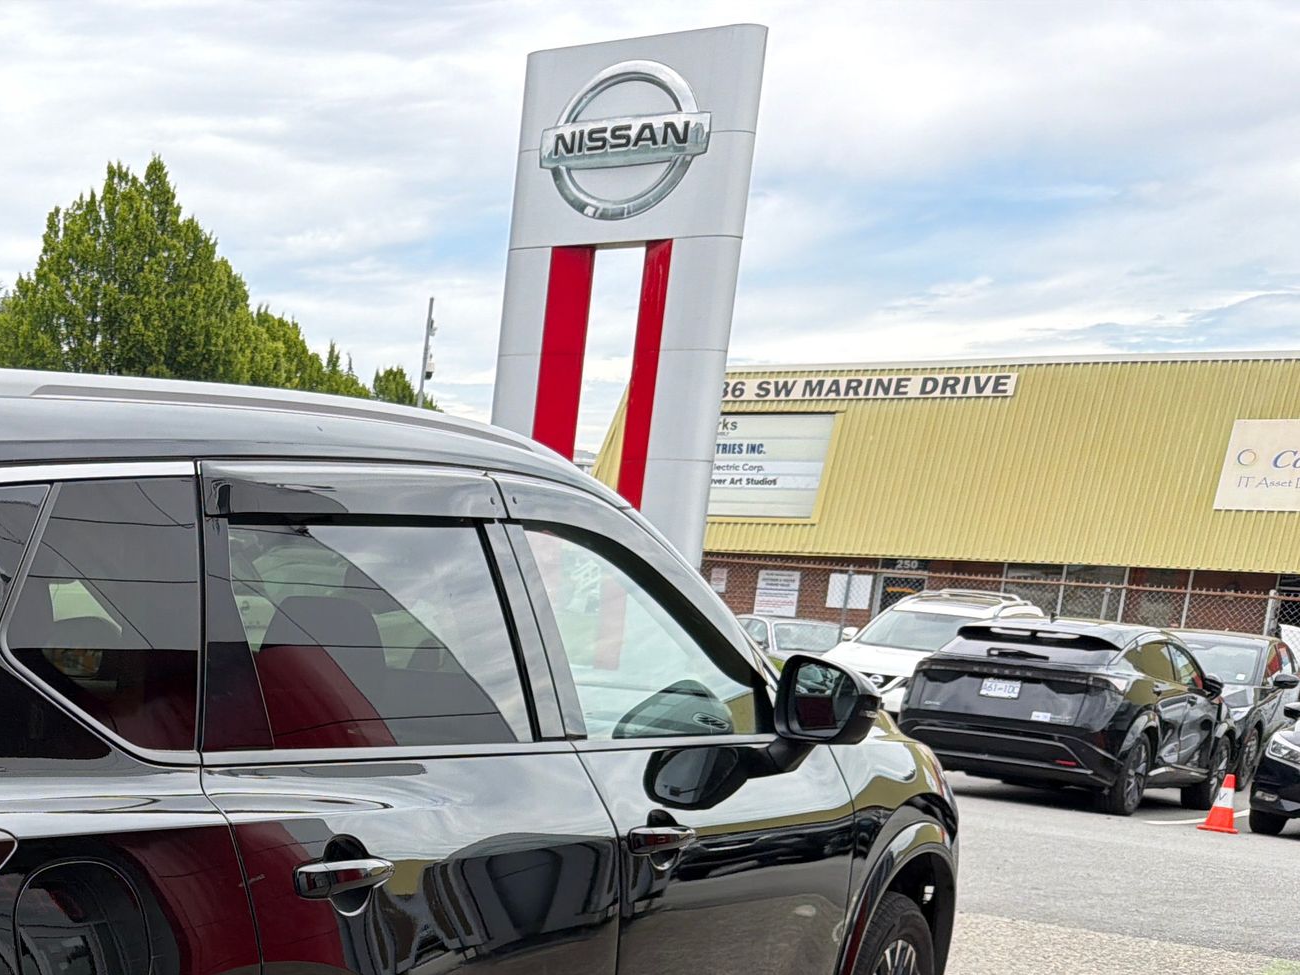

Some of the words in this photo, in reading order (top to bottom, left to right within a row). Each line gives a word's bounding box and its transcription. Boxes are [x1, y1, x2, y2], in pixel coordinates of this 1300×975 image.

[552, 120, 691, 158] NISSAN
[754, 380, 798, 398] SW
[801, 377, 912, 398] MARINE
[919, 374, 1012, 395] DRIVE
[746, 443, 767, 455] INC.
[729, 477, 742, 485] Art
[1237, 476, 1255, 488] IT
[1255, 477, 1292, 489] Asset
[895, 560, 919, 570] 250
